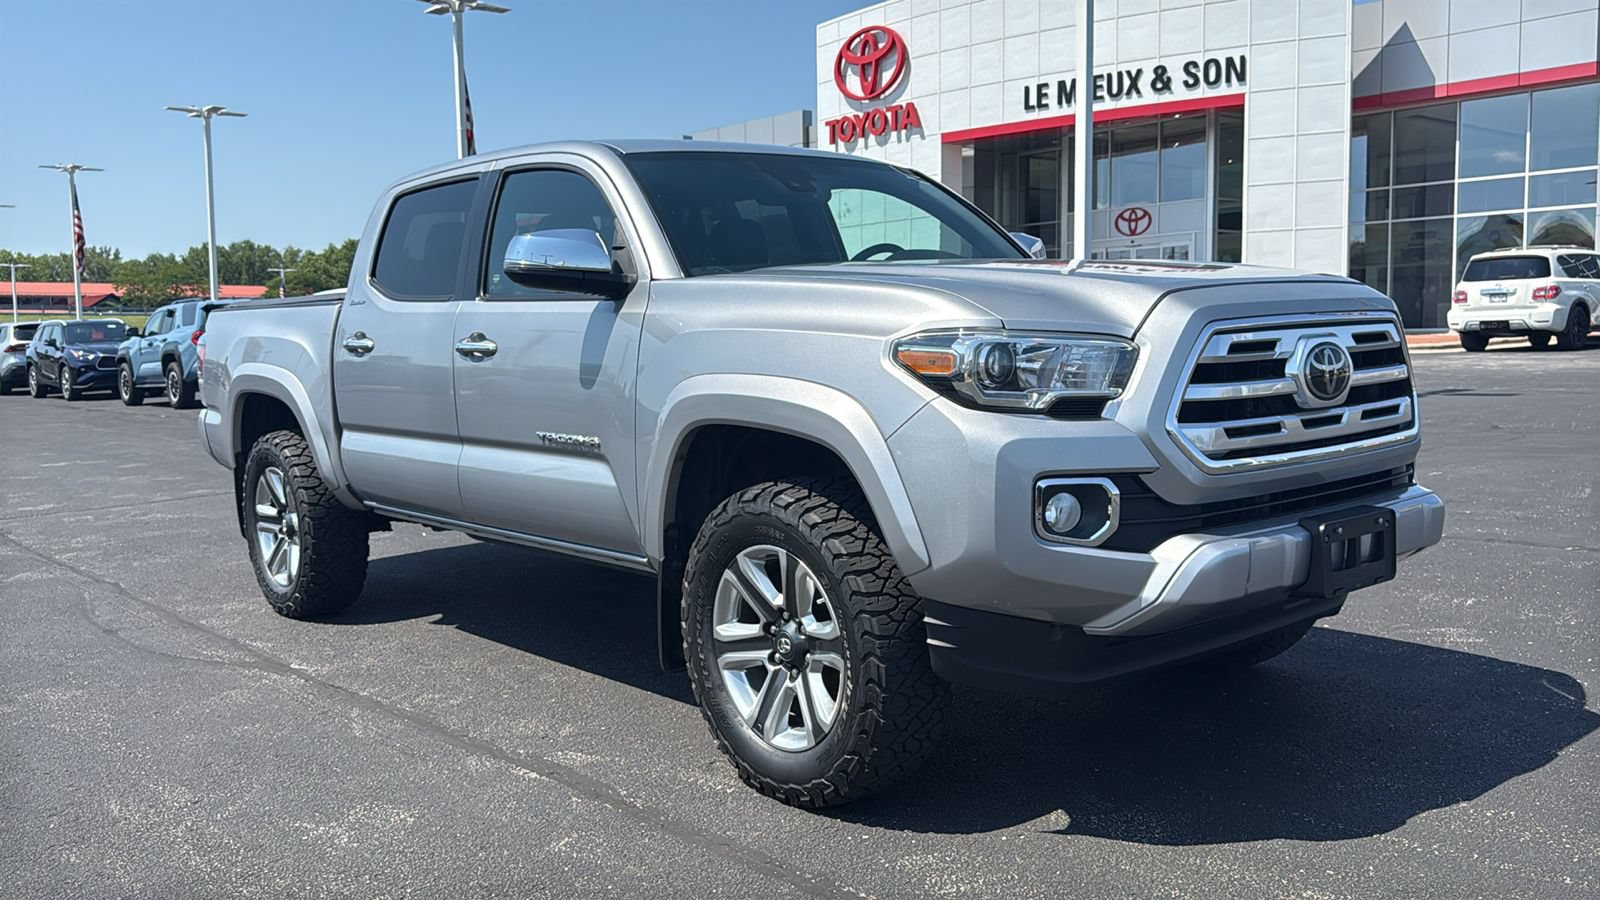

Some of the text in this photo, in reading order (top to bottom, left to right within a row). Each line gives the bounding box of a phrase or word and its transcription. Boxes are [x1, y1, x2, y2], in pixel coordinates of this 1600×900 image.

[1024, 55, 1246, 110] LE MEUX & SON
[825, 102, 921, 145] TOYOTA
